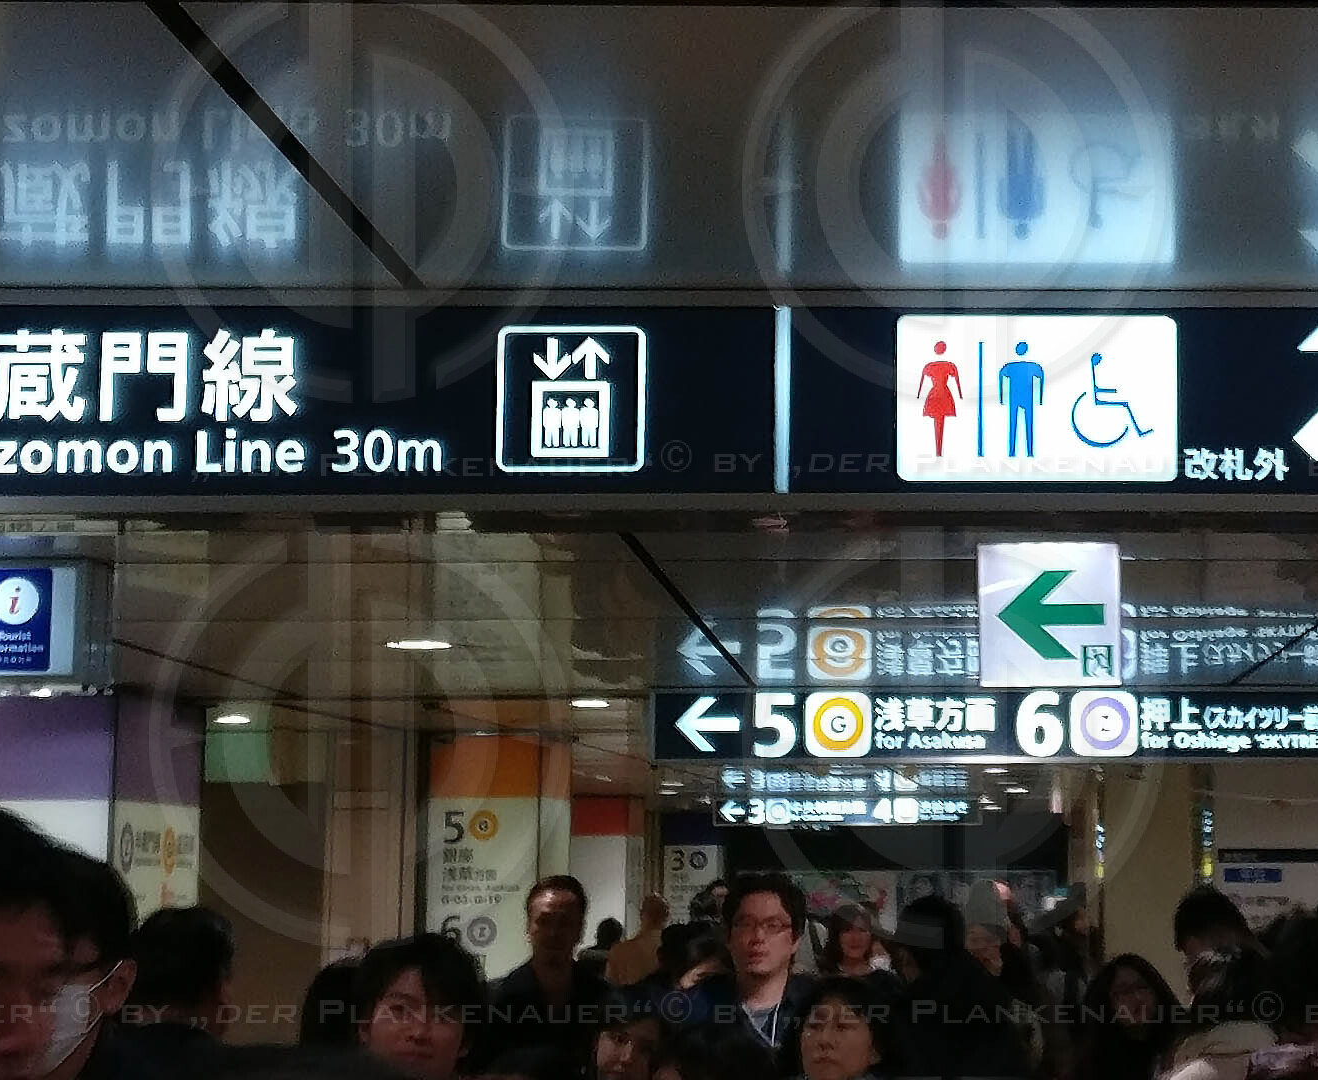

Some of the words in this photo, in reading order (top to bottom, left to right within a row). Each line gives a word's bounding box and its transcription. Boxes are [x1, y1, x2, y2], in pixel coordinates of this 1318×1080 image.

[195, 428, 306, 473] Line
[332, 429, 443, 473] 30m
[1183, 447, 1290, 481] 改札外
[753, 692, 797, 758] 5
[874, 696, 997, 732] 浅草方面
[1016, 690, 1063, 758] 6
[874, 732, 902, 750] for
[907, 732, 987, 750] Asakusa
[1140, 731, 1171, 749] for
[1173, 731, 1252, 752] Oshiage
[443, 811, 465, 843] 5
